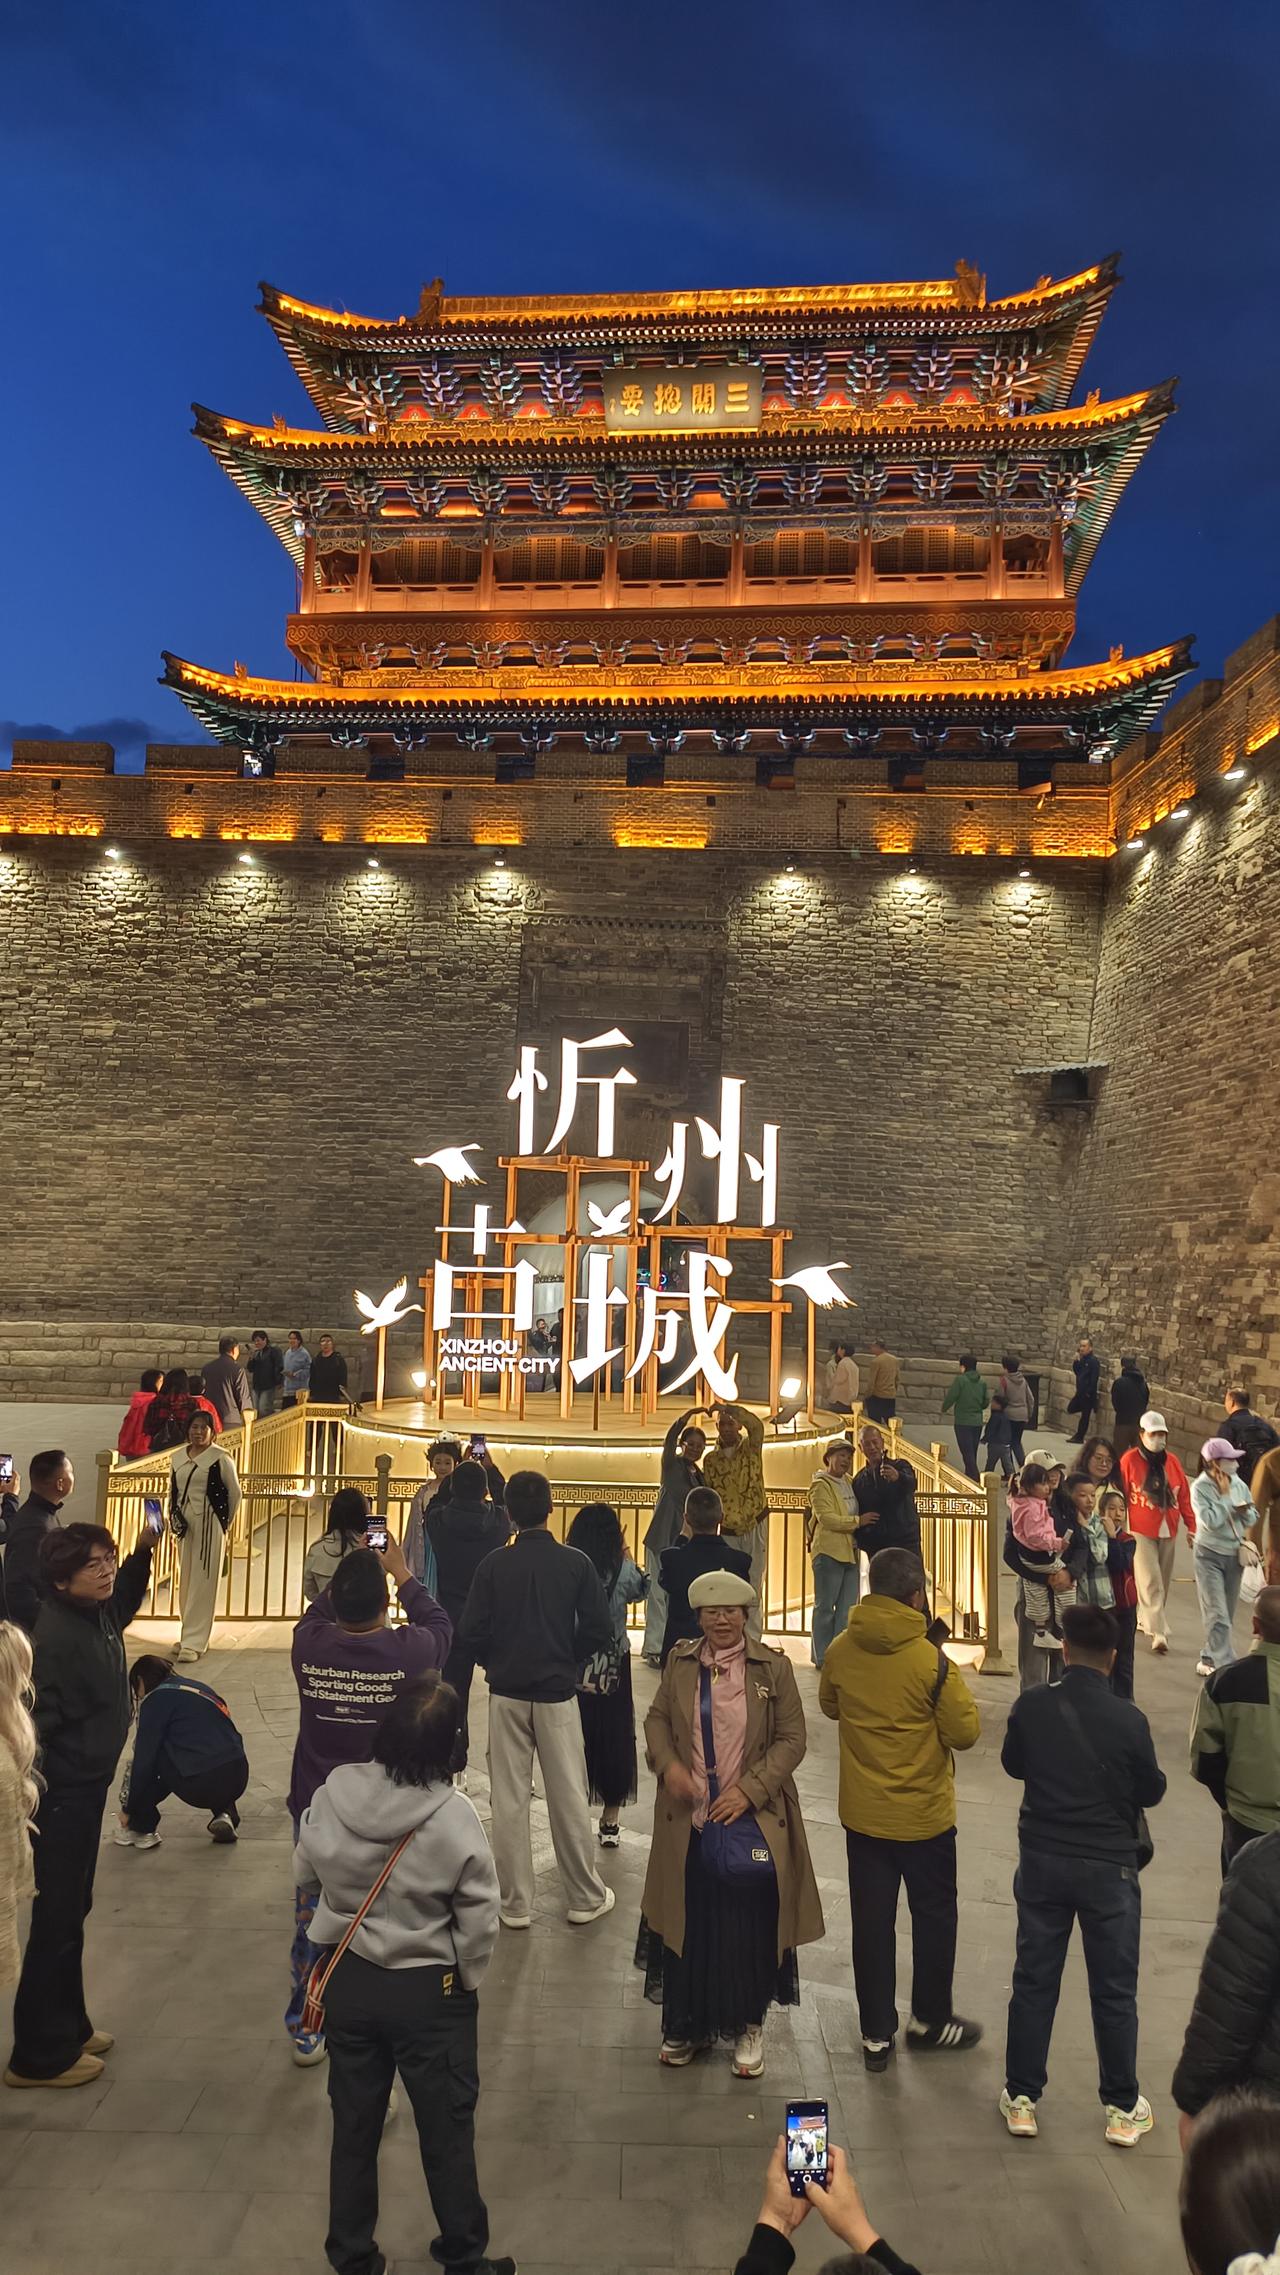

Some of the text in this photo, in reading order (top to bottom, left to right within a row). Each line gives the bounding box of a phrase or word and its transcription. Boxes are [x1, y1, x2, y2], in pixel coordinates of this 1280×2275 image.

[506, 1027, 781, 1227] 忻州
[433, 1203, 739, 1401] 古城
[439, 1338, 518, 1355] XINZHOU
[438, 1356, 560, 1374] ANCIENT CITY
[301, 1663, 405, 1681] Suburban Research
[308, 1677, 393, 1692] Sporting Goods
[318, 1690, 374, 1703] Statement
